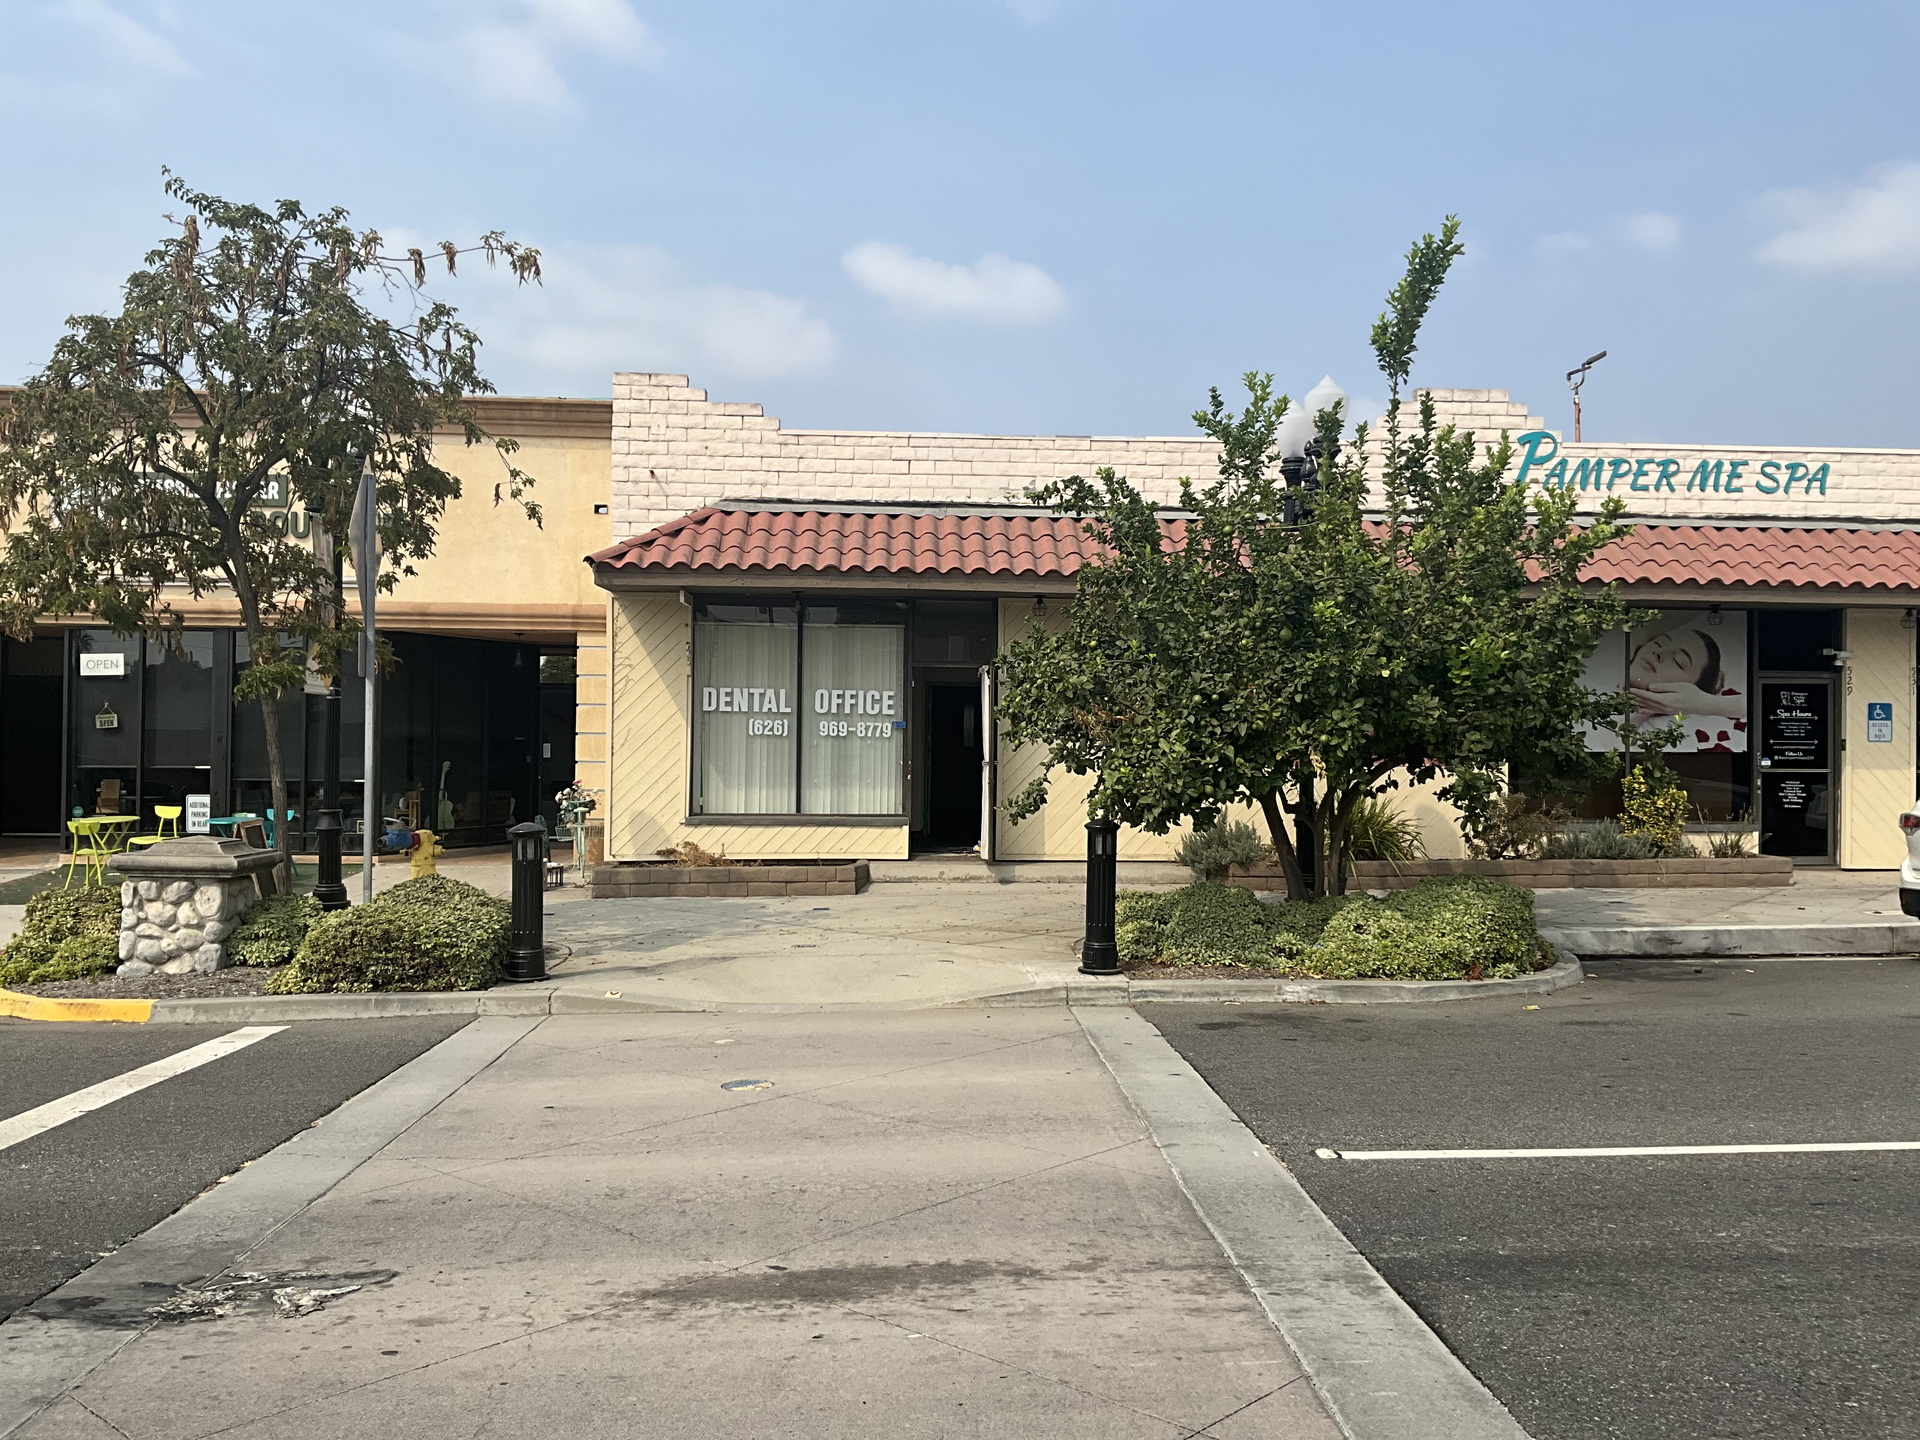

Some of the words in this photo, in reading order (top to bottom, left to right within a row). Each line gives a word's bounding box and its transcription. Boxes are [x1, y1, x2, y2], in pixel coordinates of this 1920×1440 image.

[1517, 430, 1681, 493] PAMPER
[1686, 458, 1749, 493] ME
[1755, 461, 1831, 496] SPA
[85, 659, 119, 670] OPEN
[702, 687, 792, 713] DENTAL
[814, 688, 895, 715] OFFICE
[99, 719, 115, 728] OPEN
[748, 718, 789, 737] (626)
[819, 720, 892, 738] 969-8779
